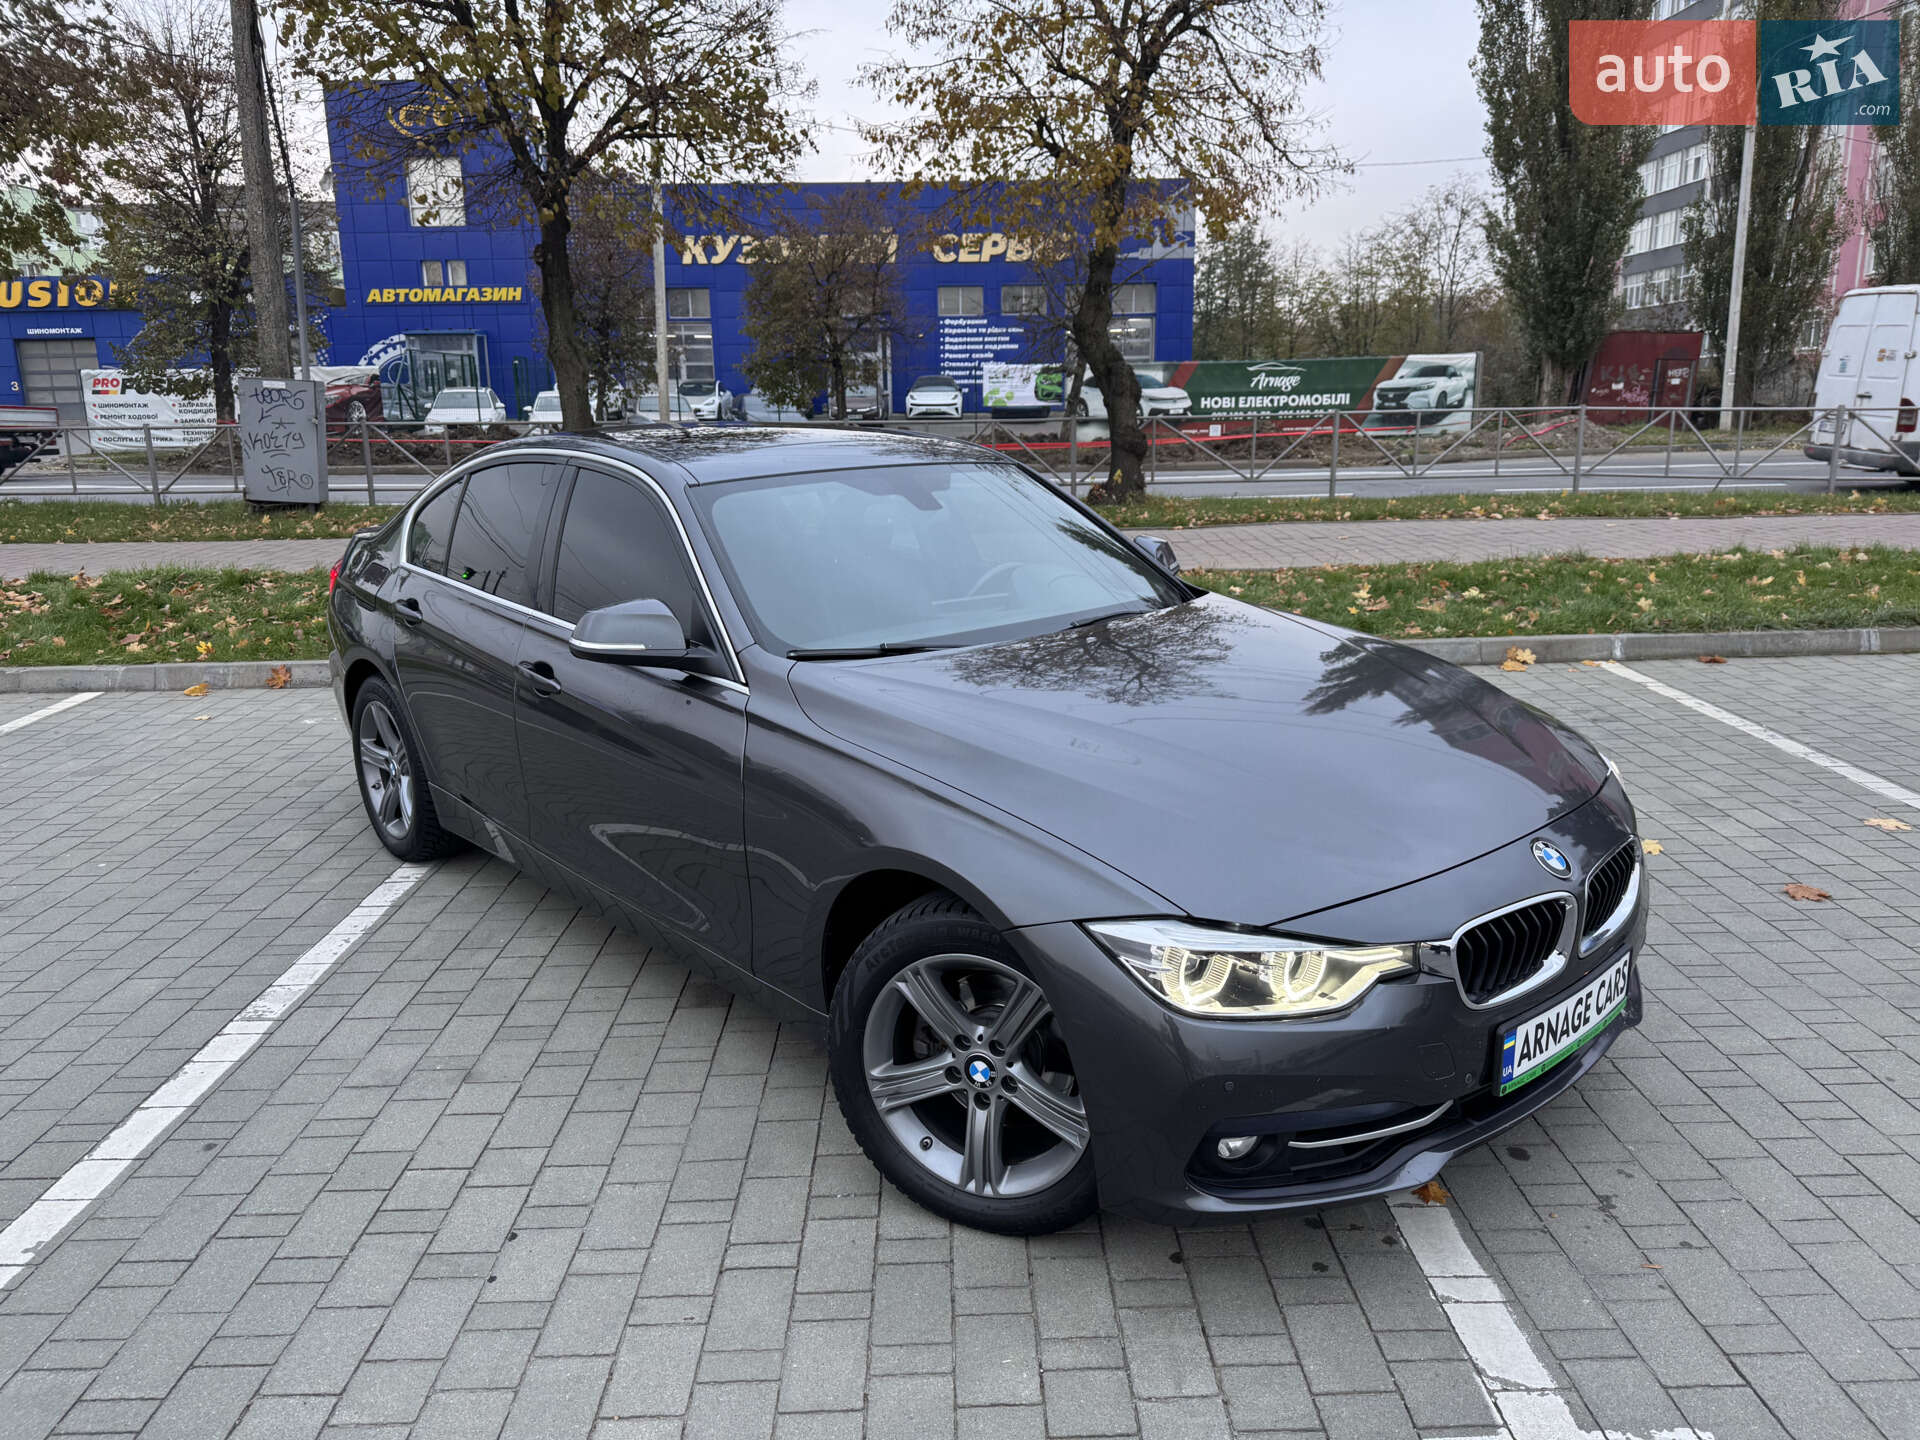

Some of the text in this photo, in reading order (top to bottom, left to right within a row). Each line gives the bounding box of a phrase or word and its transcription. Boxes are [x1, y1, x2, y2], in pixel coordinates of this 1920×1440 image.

[366, 287, 522, 303] АВТОМАГАЗИН
[26, 327, 83, 335] ШИНОМОНТАЖ
[11, 381, 19, 391] 3
[92, 377, 120, 388] PRO
[1250, 372, 1301, 392] Arnage
[1200, 393, 1350, 409] НОВІ ЕЛЕКТРОМОБІЛІ
[1516, 959, 1628, 1068] ARNAGE CARS
[1502, 1064, 1513, 1077] UA
